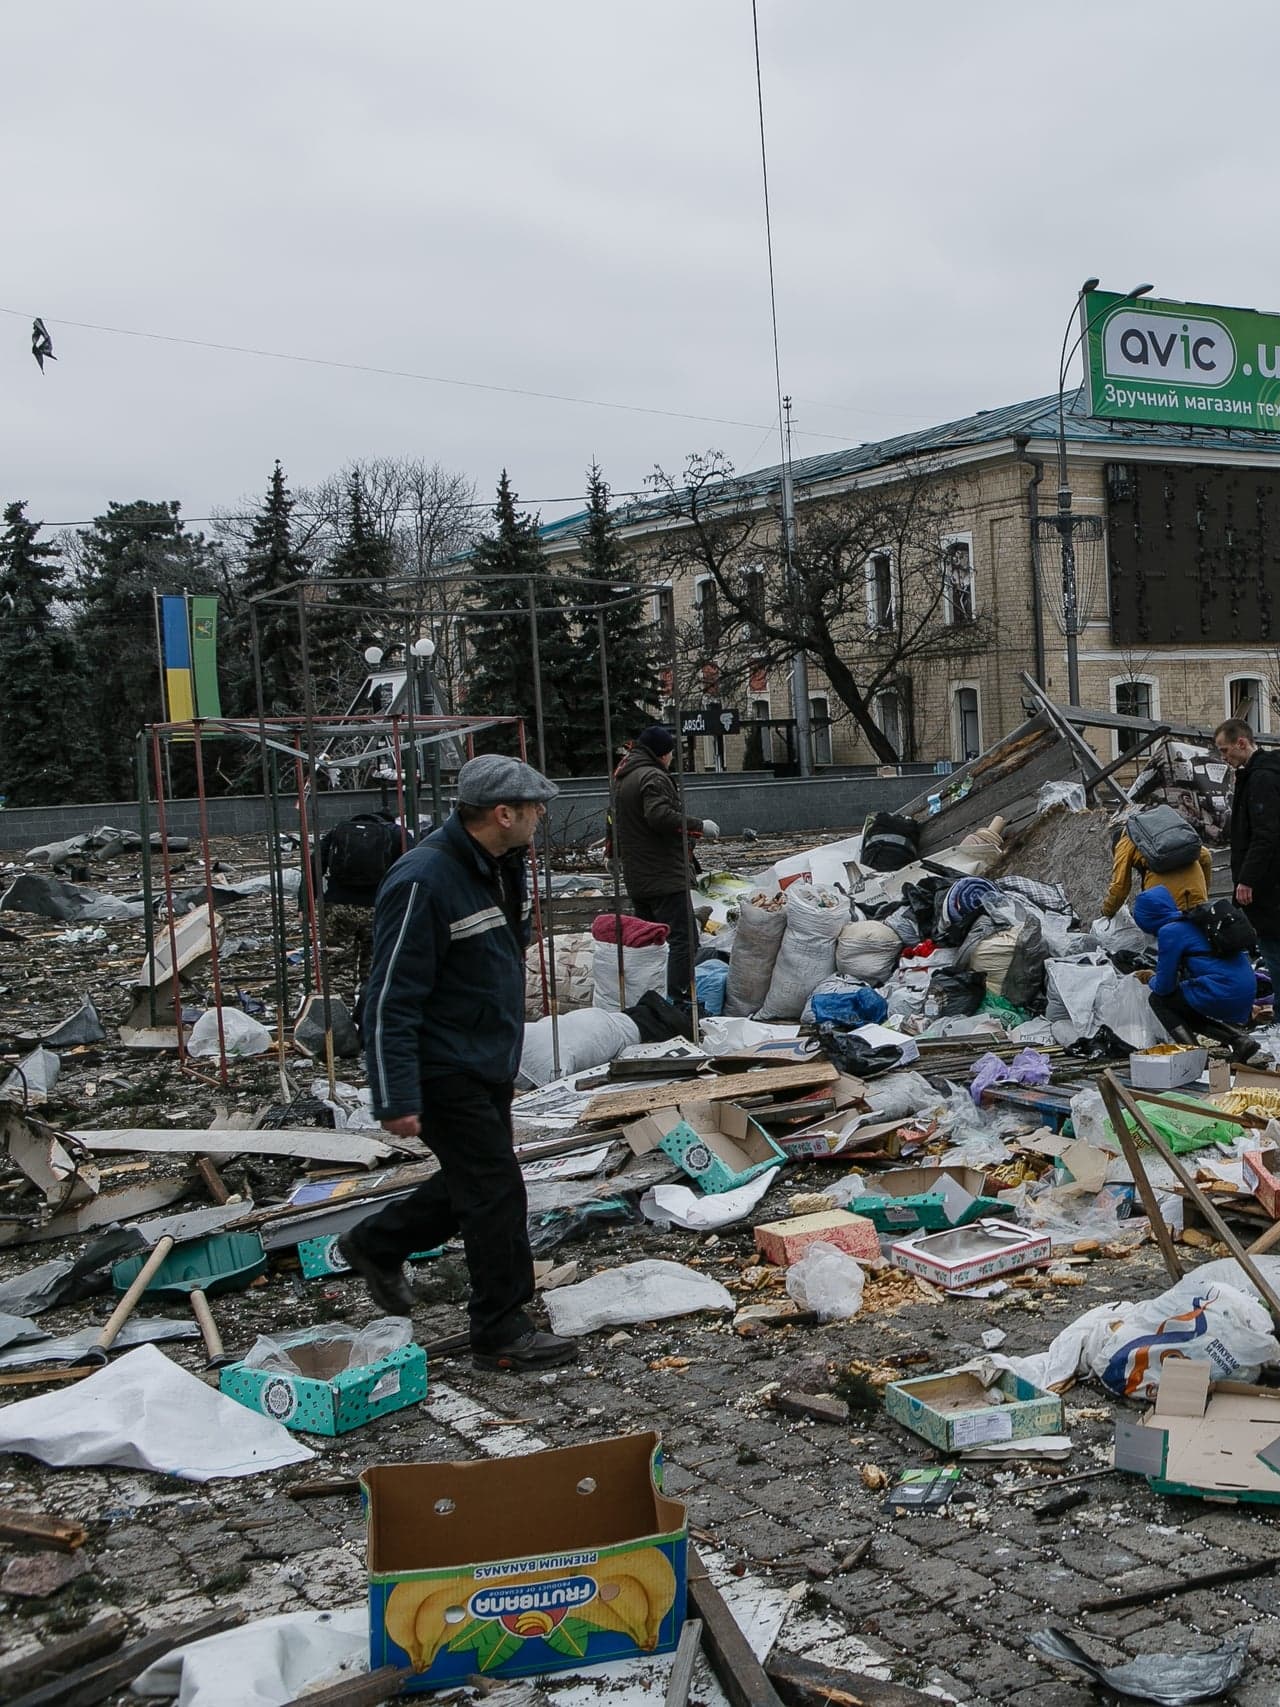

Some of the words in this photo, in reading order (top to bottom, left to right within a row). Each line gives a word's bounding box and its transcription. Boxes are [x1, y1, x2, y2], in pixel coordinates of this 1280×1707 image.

[1119, 324, 1217, 372] avic
[1104, 384, 1179, 409] Зручний
[1184, 394, 1253, 416] магазин
[475, 1560, 535, 1578] BANANAS
[539, 1553, 597, 1570] PREMIUM
[488, 1587, 524, 1597] ECUADOR
[538, 1580, 571, 1591] PRODUCT
[475, 1583, 591, 1613] FRUTIBANA
